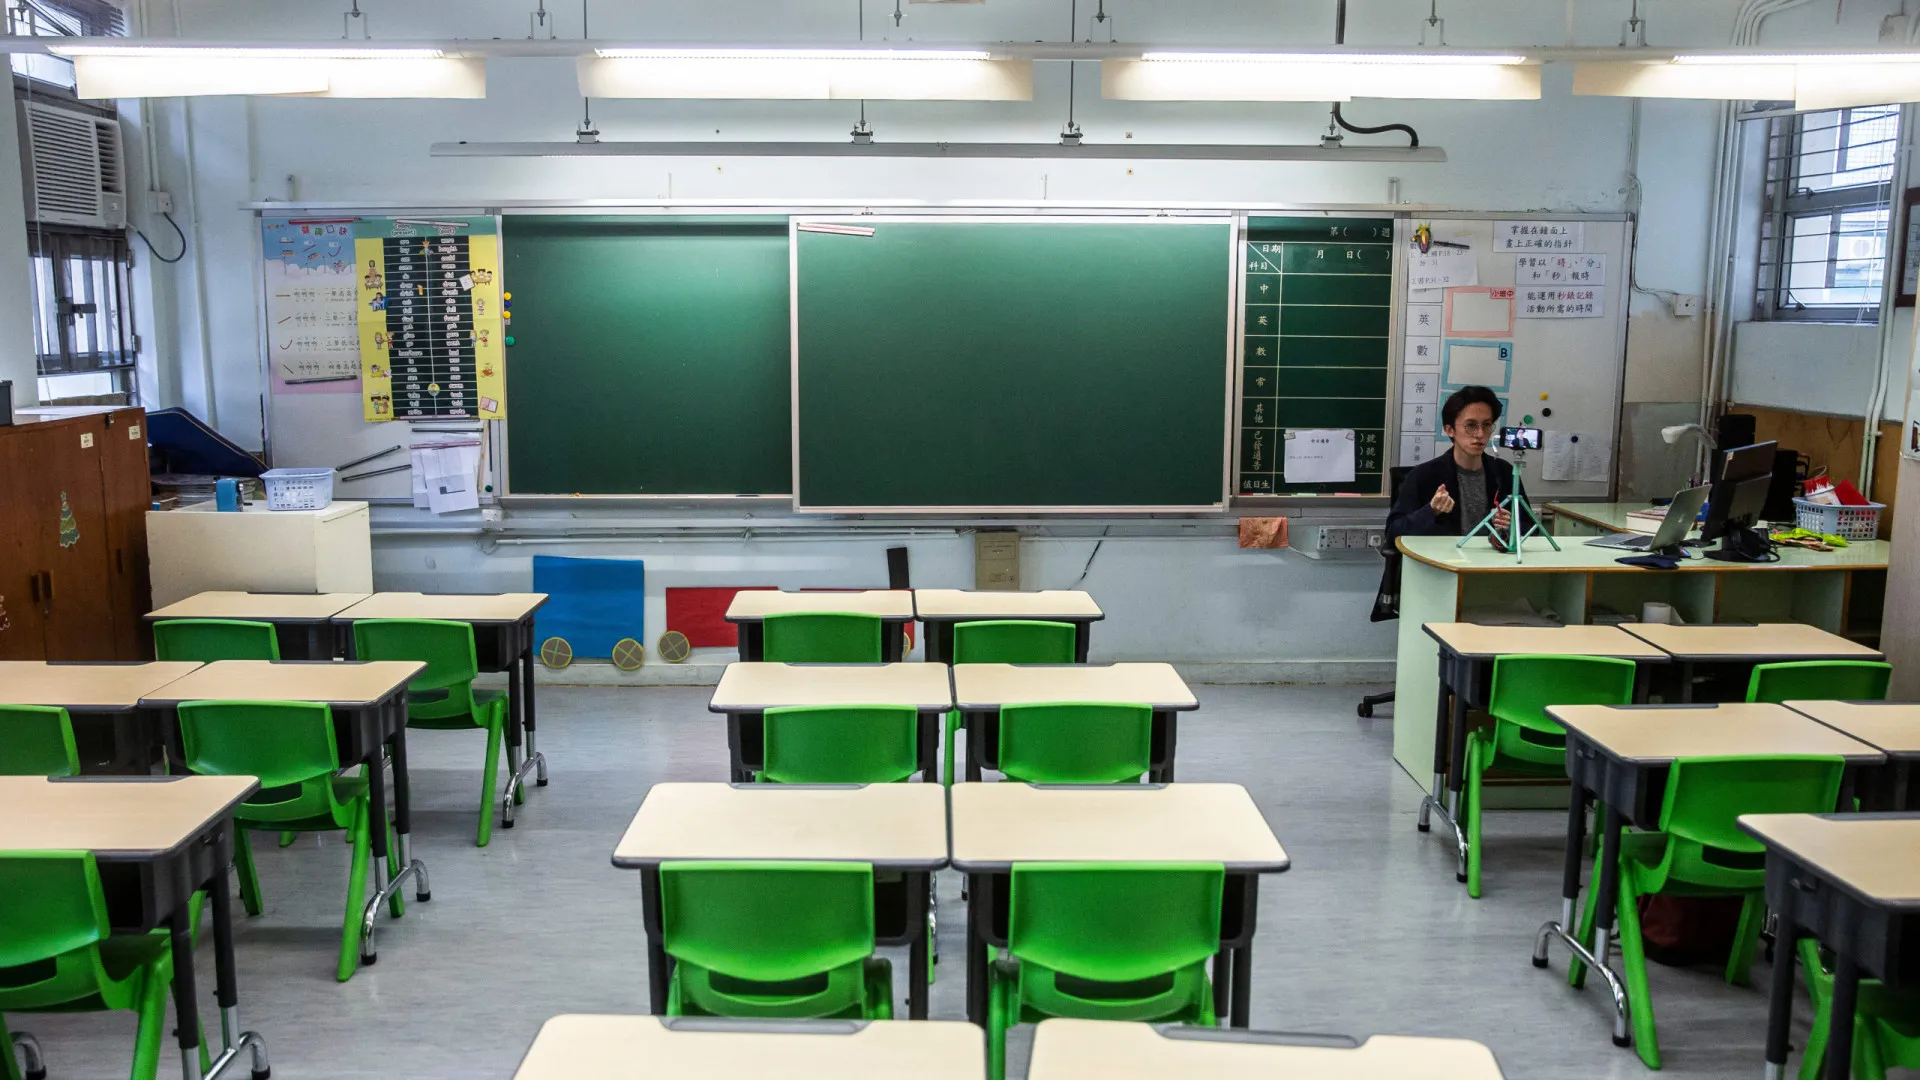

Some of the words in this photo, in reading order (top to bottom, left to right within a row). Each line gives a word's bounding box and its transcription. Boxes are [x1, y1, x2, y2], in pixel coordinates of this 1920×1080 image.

[1511, 226, 1568, 235] 掌握在鐘面上
[1263, 244, 1281, 253] 日期
[1506, 240, 1573, 248] 畫上正確的指針
[1317, 250, 1324, 259] 月
[1249, 262, 1268, 270] 科目
[1260, 284, 1269, 294] 中
[1528, 291, 1593, 300] 能運用秒錶記錄
[1527, 304, 1593, 314] 活動所需的時間
[1258, 316, 1268, 326] 英
[1418, 314, 1429, 326] 英
[1256, 346, 1267, 356] 數
[1417, 345, 1427, 356] 數
[1501, 348, 1508, 358] B
[1256, 377, 1266, 387] 常
[1415, 382, 1426, 393] 常
[1254, 403, 1264, 423] 其他
[1243, 480, 1270, 489] 值日生
